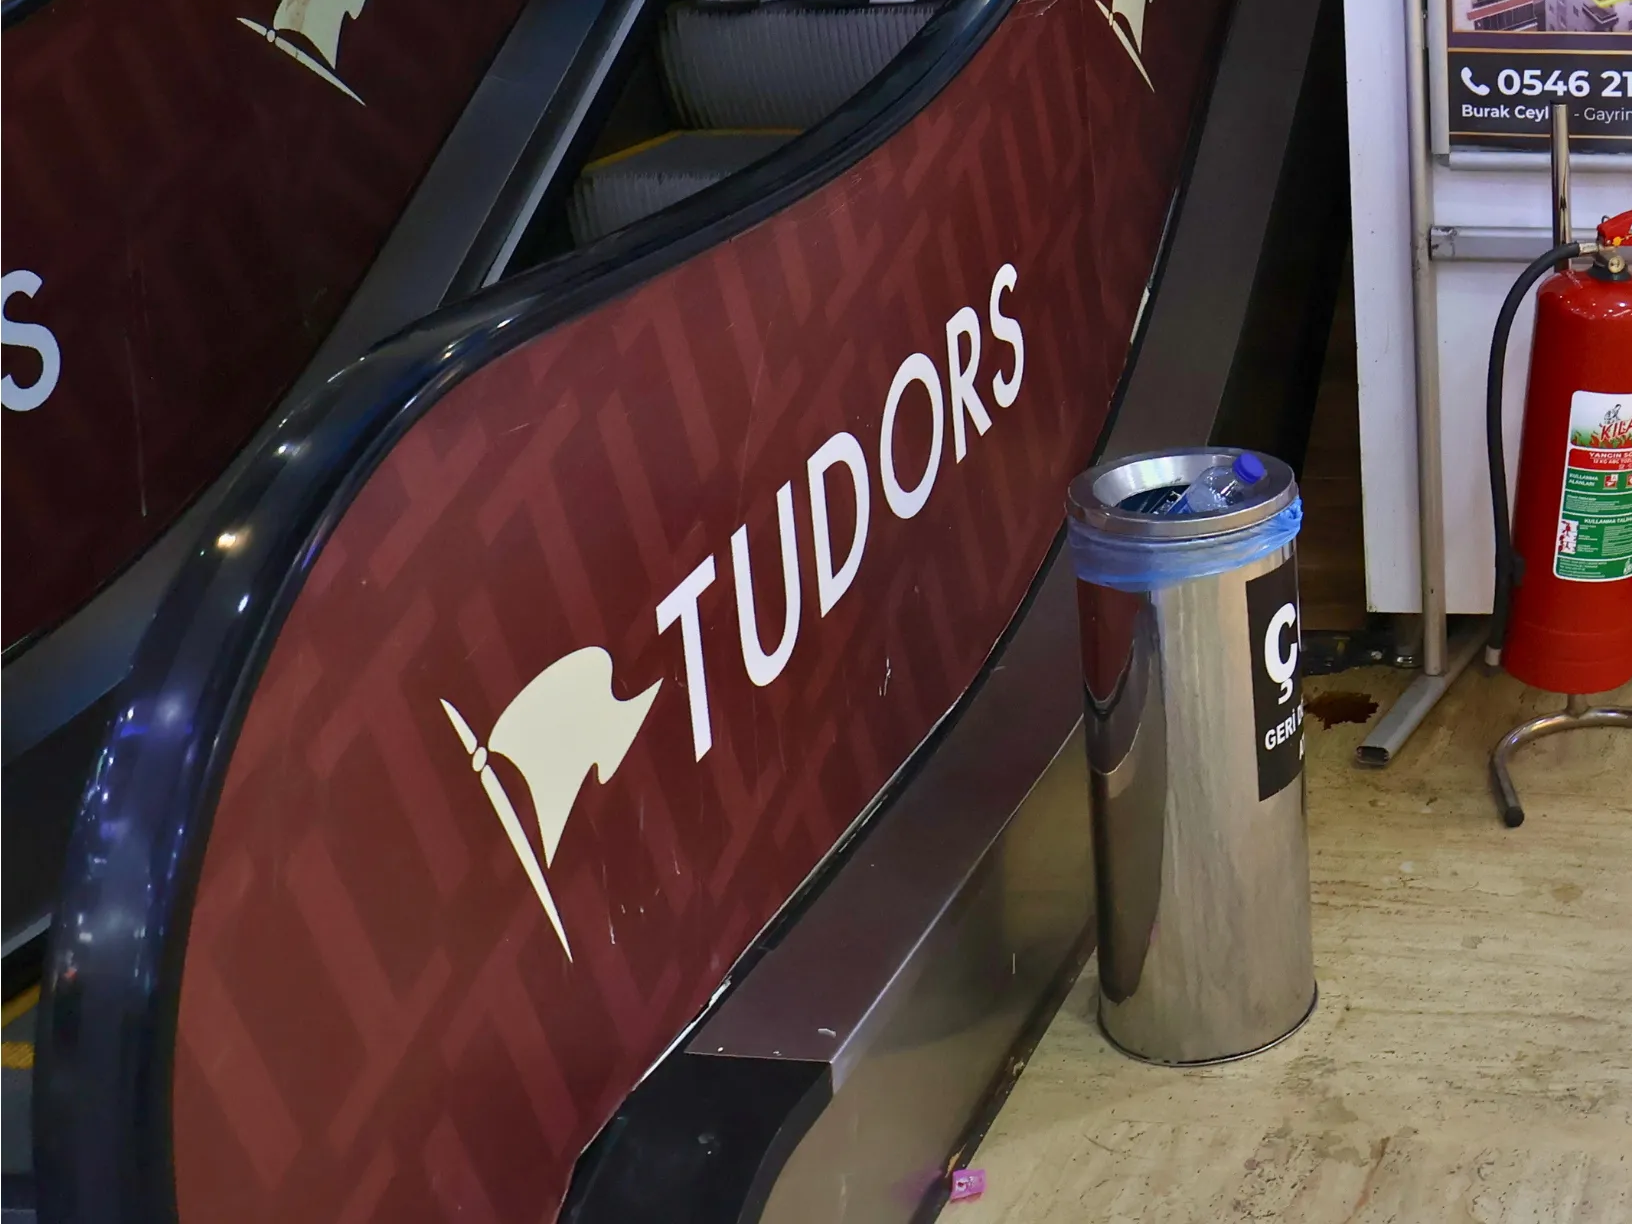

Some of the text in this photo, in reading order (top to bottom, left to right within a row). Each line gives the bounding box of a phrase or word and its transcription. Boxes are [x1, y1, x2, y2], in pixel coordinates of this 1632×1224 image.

[1497, 69, 1591, 97] 0546
[1461, 104, 1510, 119] Burak
[1514, 106, 1549, 122] Ceyl
[655, 262, 1025, 763] TUDORS
[1265, 708, 1296, 750] GERİ
